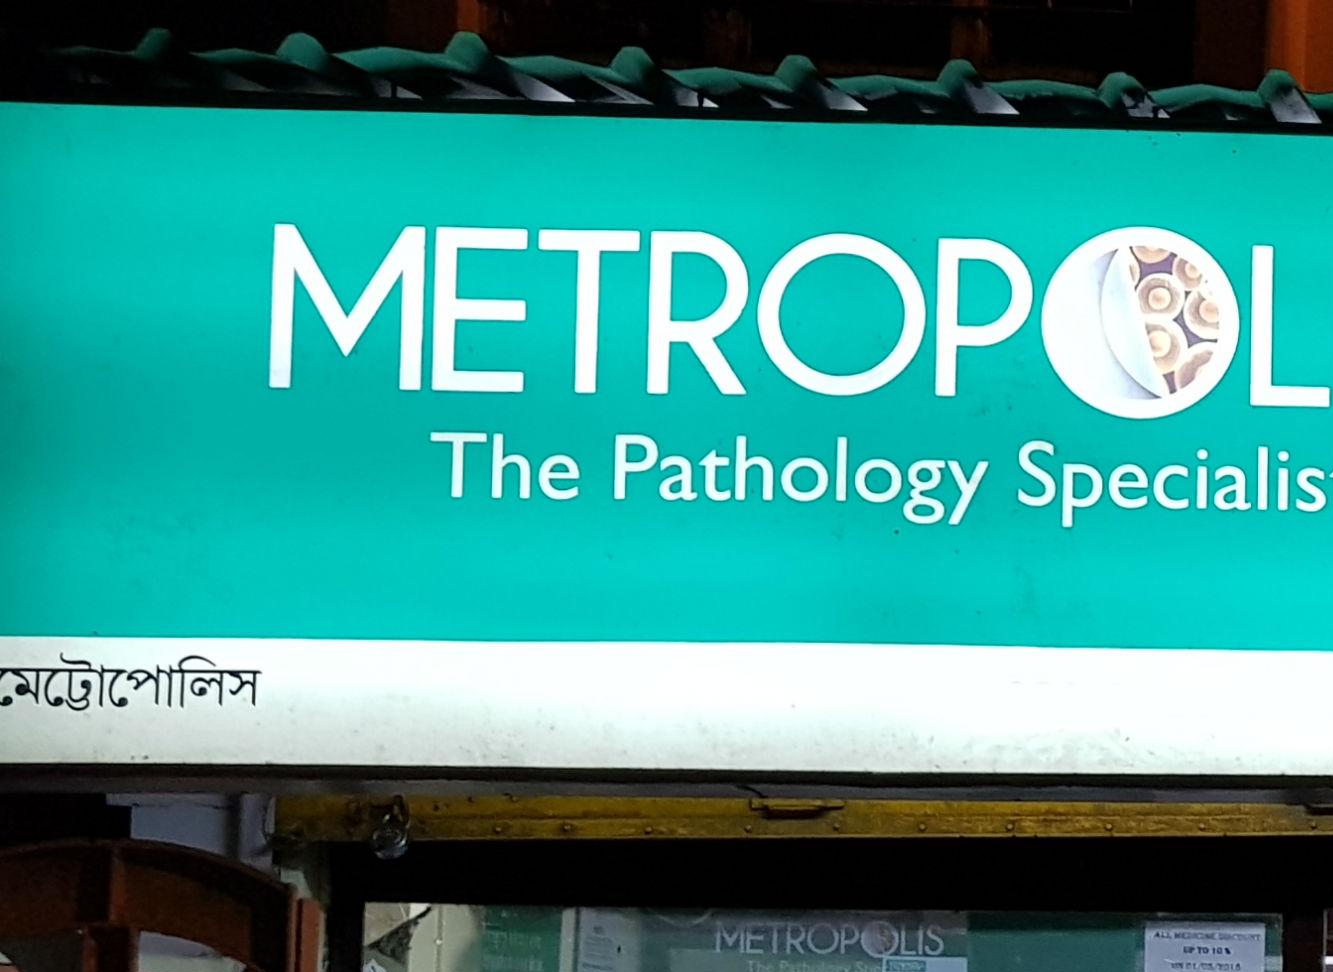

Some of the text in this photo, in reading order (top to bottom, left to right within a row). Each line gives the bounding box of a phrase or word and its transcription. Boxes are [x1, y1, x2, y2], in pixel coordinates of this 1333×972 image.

[430, 432, 580, 502] The
[612, 433, 989, 527] Pathology
[714, 921, 946, 958] METROPOLIS
